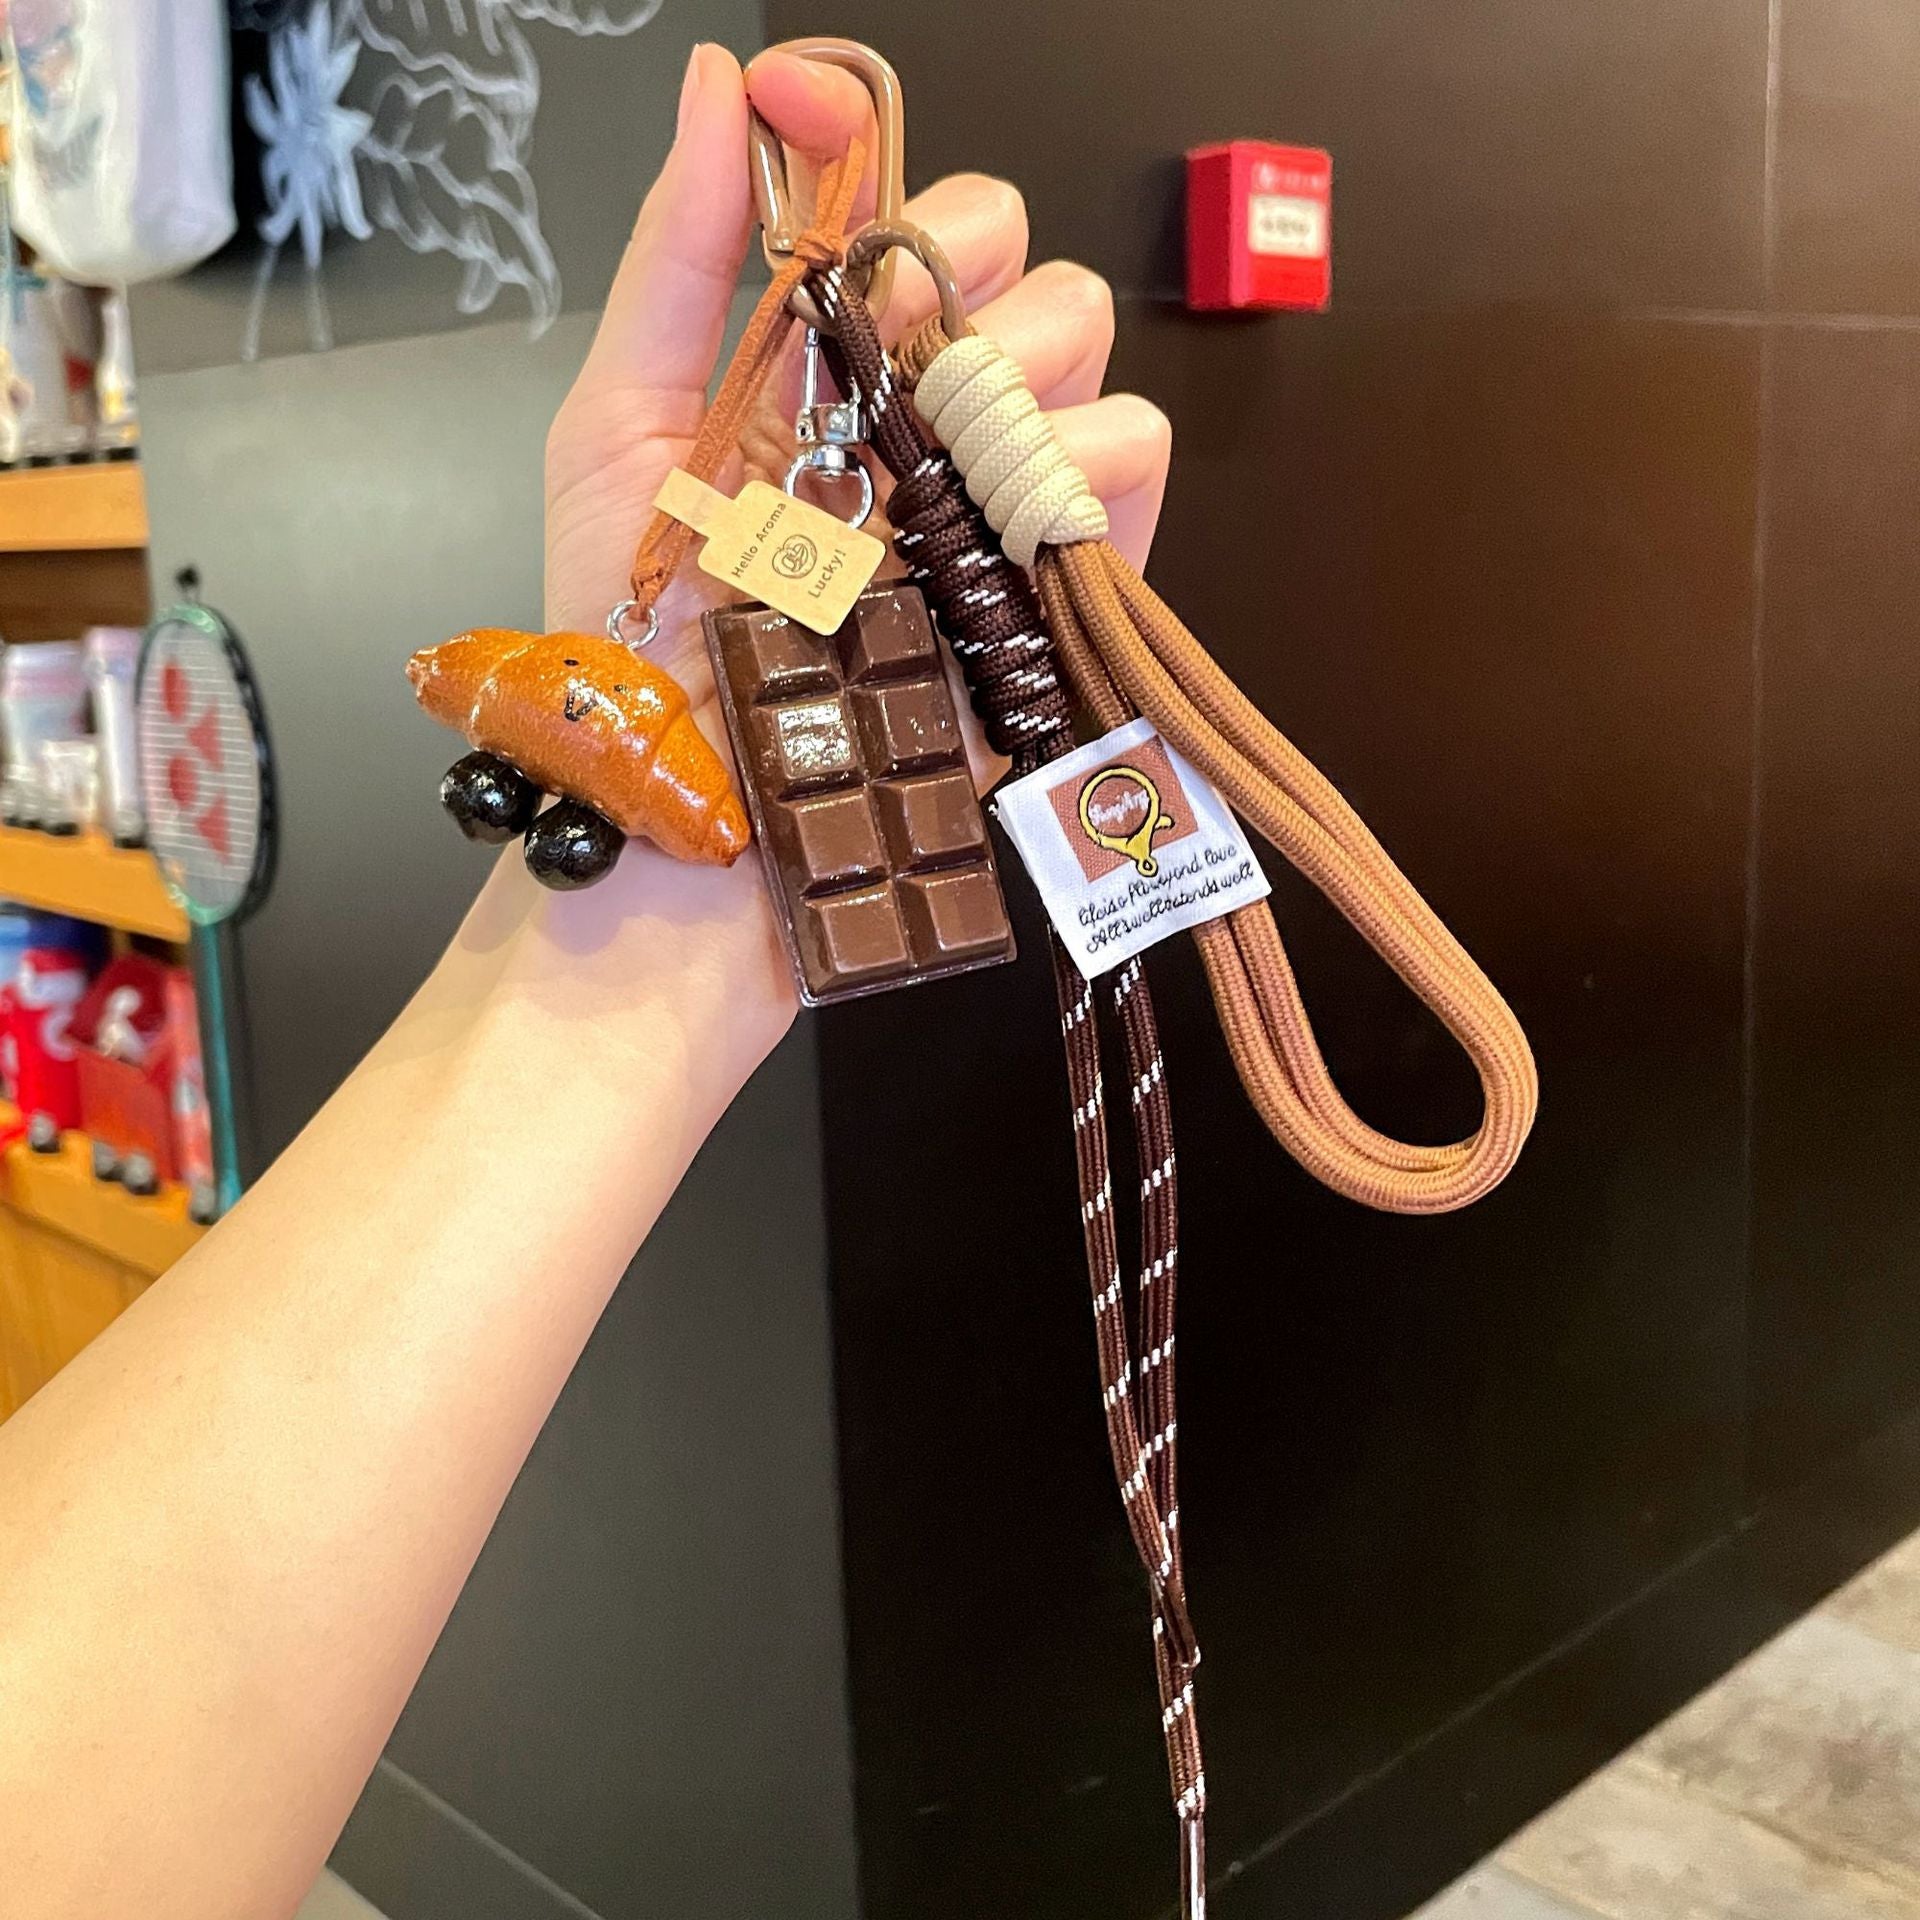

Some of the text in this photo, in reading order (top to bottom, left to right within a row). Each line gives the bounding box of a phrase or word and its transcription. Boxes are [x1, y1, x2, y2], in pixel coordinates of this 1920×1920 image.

[731, 502, 787, 578] Hello Aroma
[807, 548, 847, 599] Lucky!
